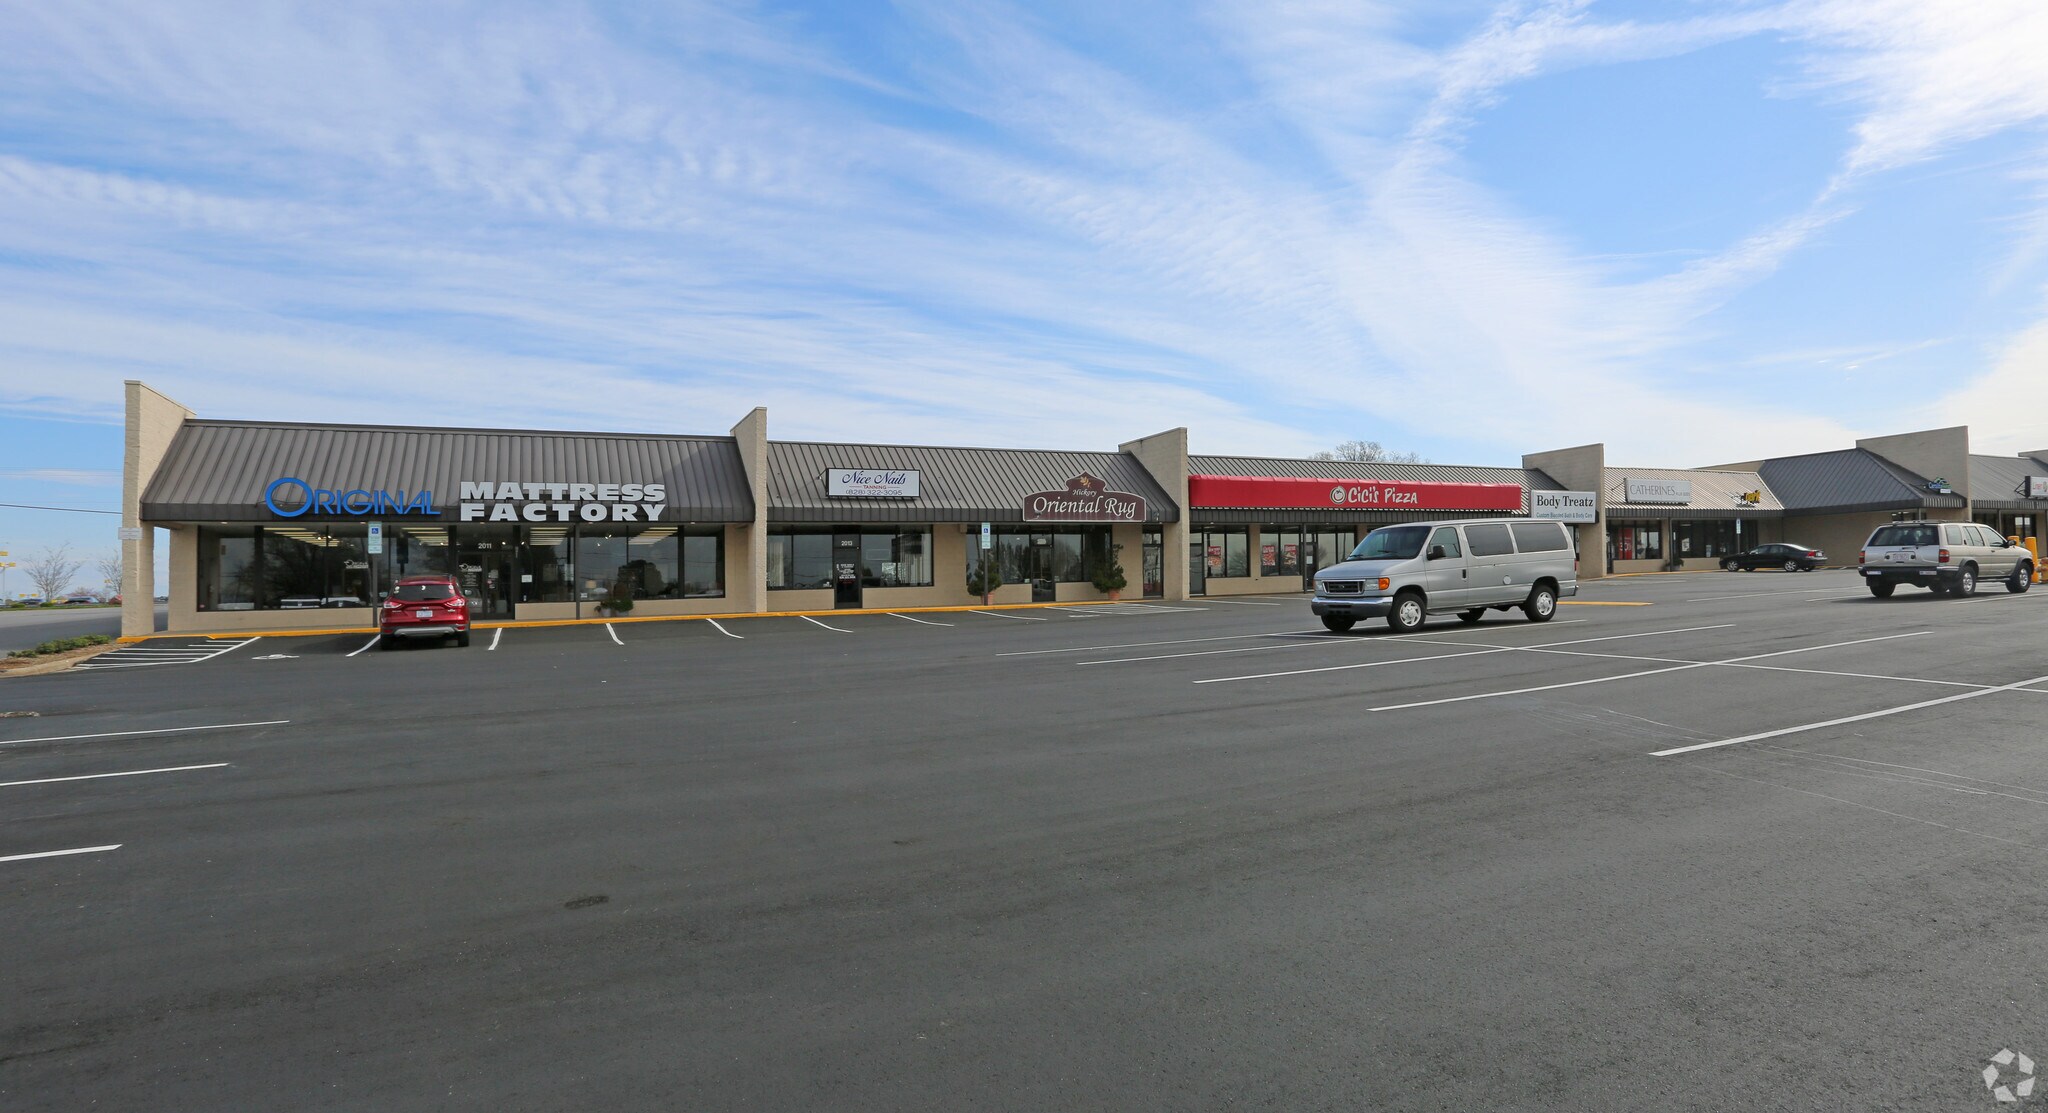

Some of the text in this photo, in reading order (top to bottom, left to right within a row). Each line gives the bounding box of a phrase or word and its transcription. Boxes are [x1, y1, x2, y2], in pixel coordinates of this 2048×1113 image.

[842, 470, 906, 484] Nice Nails
[265, 477, 441, 517] ORIGINAL
[460, 481, 666, 501] MATTRESS
[1072, 488, 1097, 496] Hickory
[1630, 484, 1676, 496] CATHERINES
[1033, 496, 1137, 519] Oriental Rug
[1536, 494, 1594, 509] Body Treatz
[460, 503, 666, 522] FACTORY
